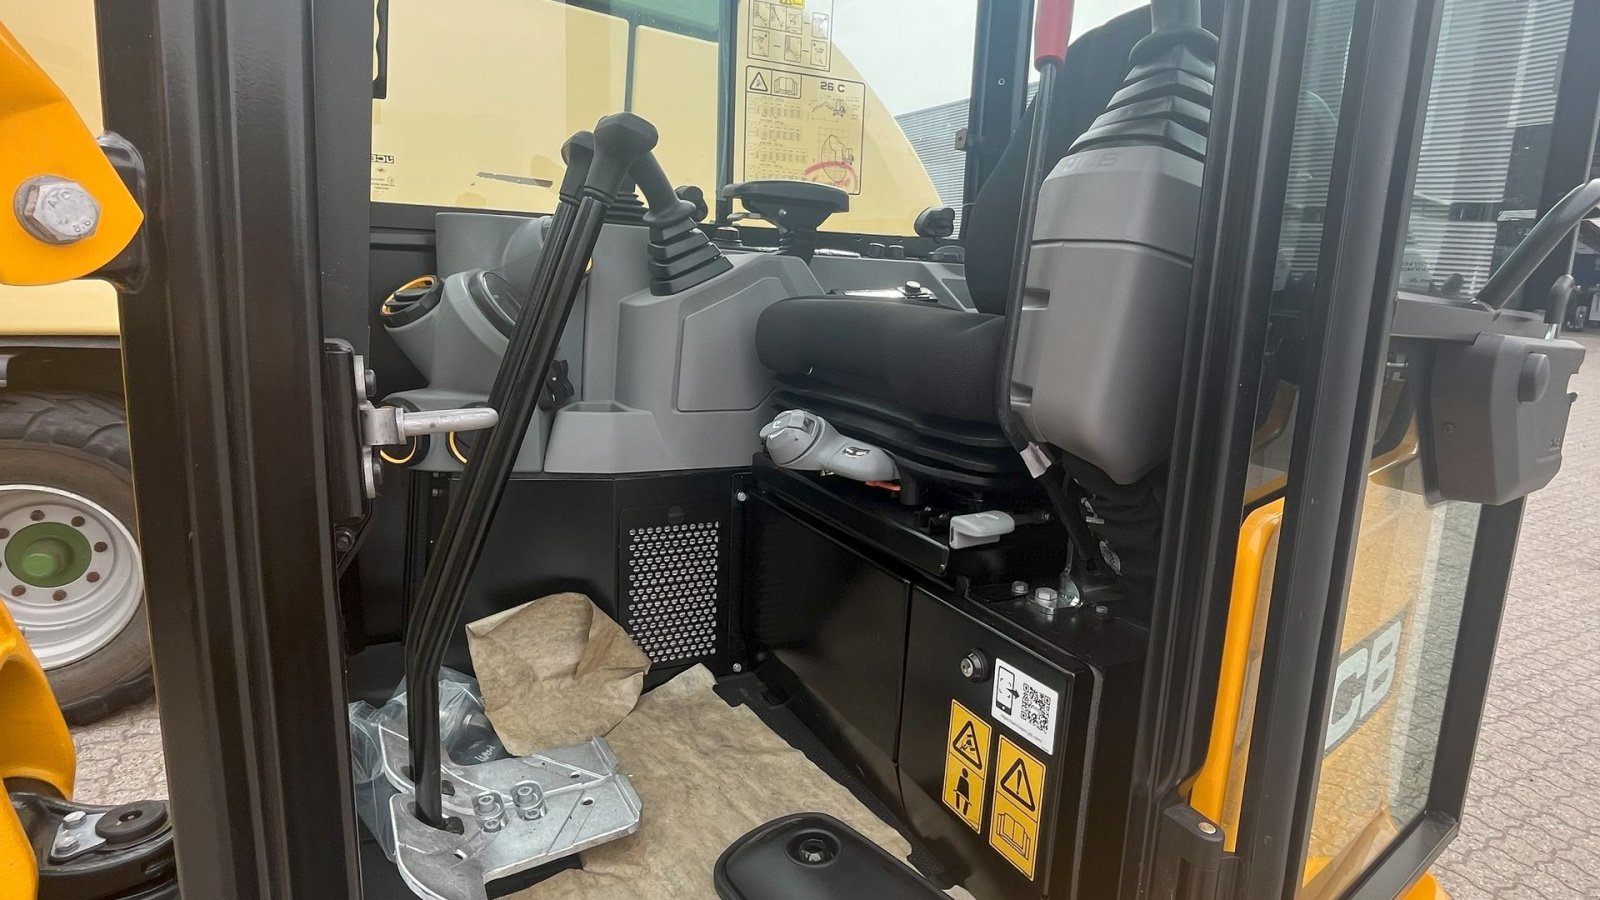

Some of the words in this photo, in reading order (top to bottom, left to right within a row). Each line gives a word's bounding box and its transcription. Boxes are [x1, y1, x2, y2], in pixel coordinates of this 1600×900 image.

[820, 81, 835, 91] 26
[837, 84, 846, 93] C
[1324, 620, 1402, 751] CB
